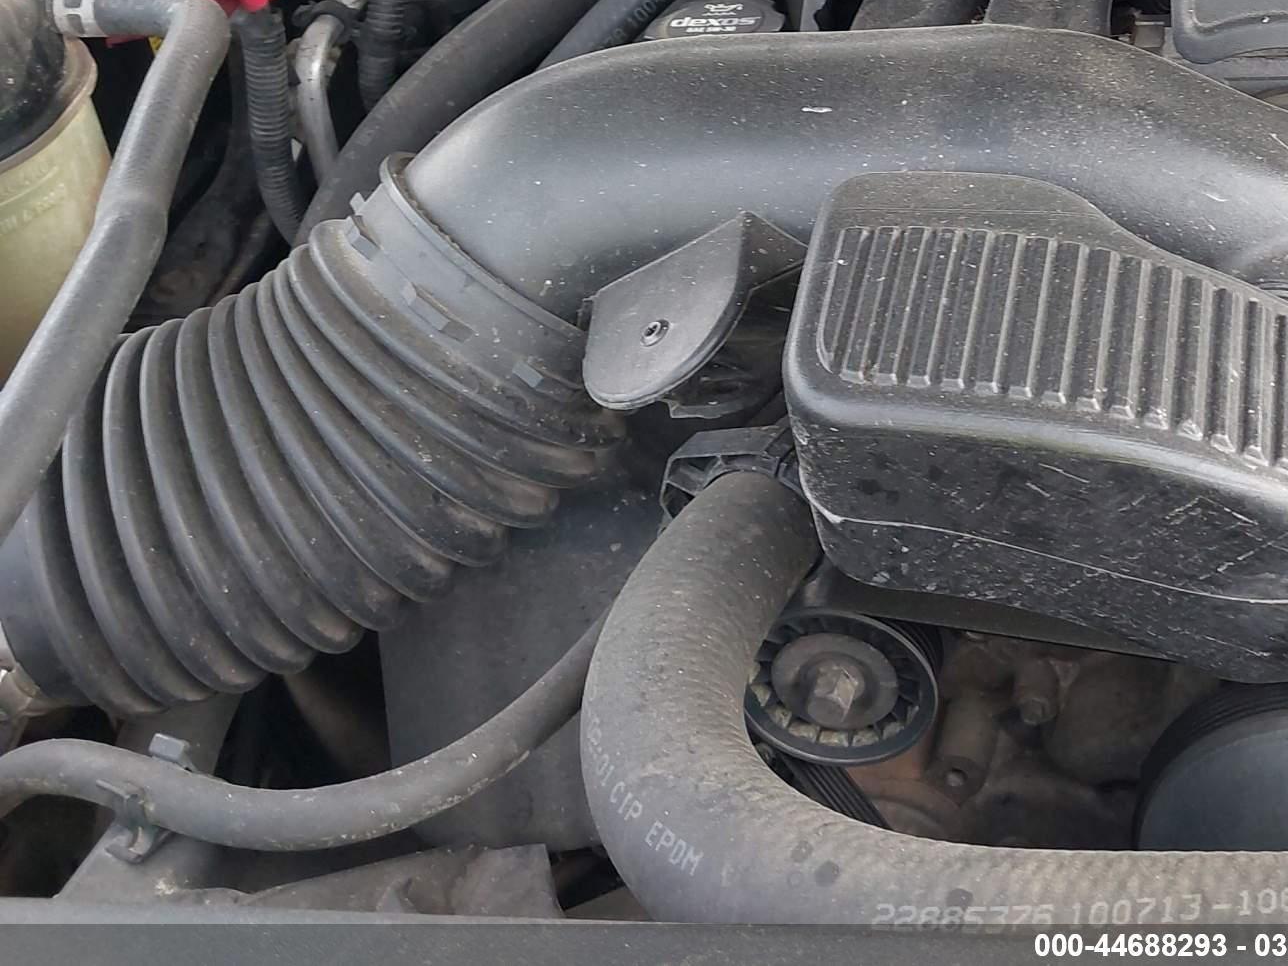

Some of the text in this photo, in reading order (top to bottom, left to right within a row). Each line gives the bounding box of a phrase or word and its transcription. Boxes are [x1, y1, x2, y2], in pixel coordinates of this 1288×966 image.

[670, 16, 762, 27] dexos
[609, 781, 643, 821] CIP
[645, 819, 704, 877] EPDM
